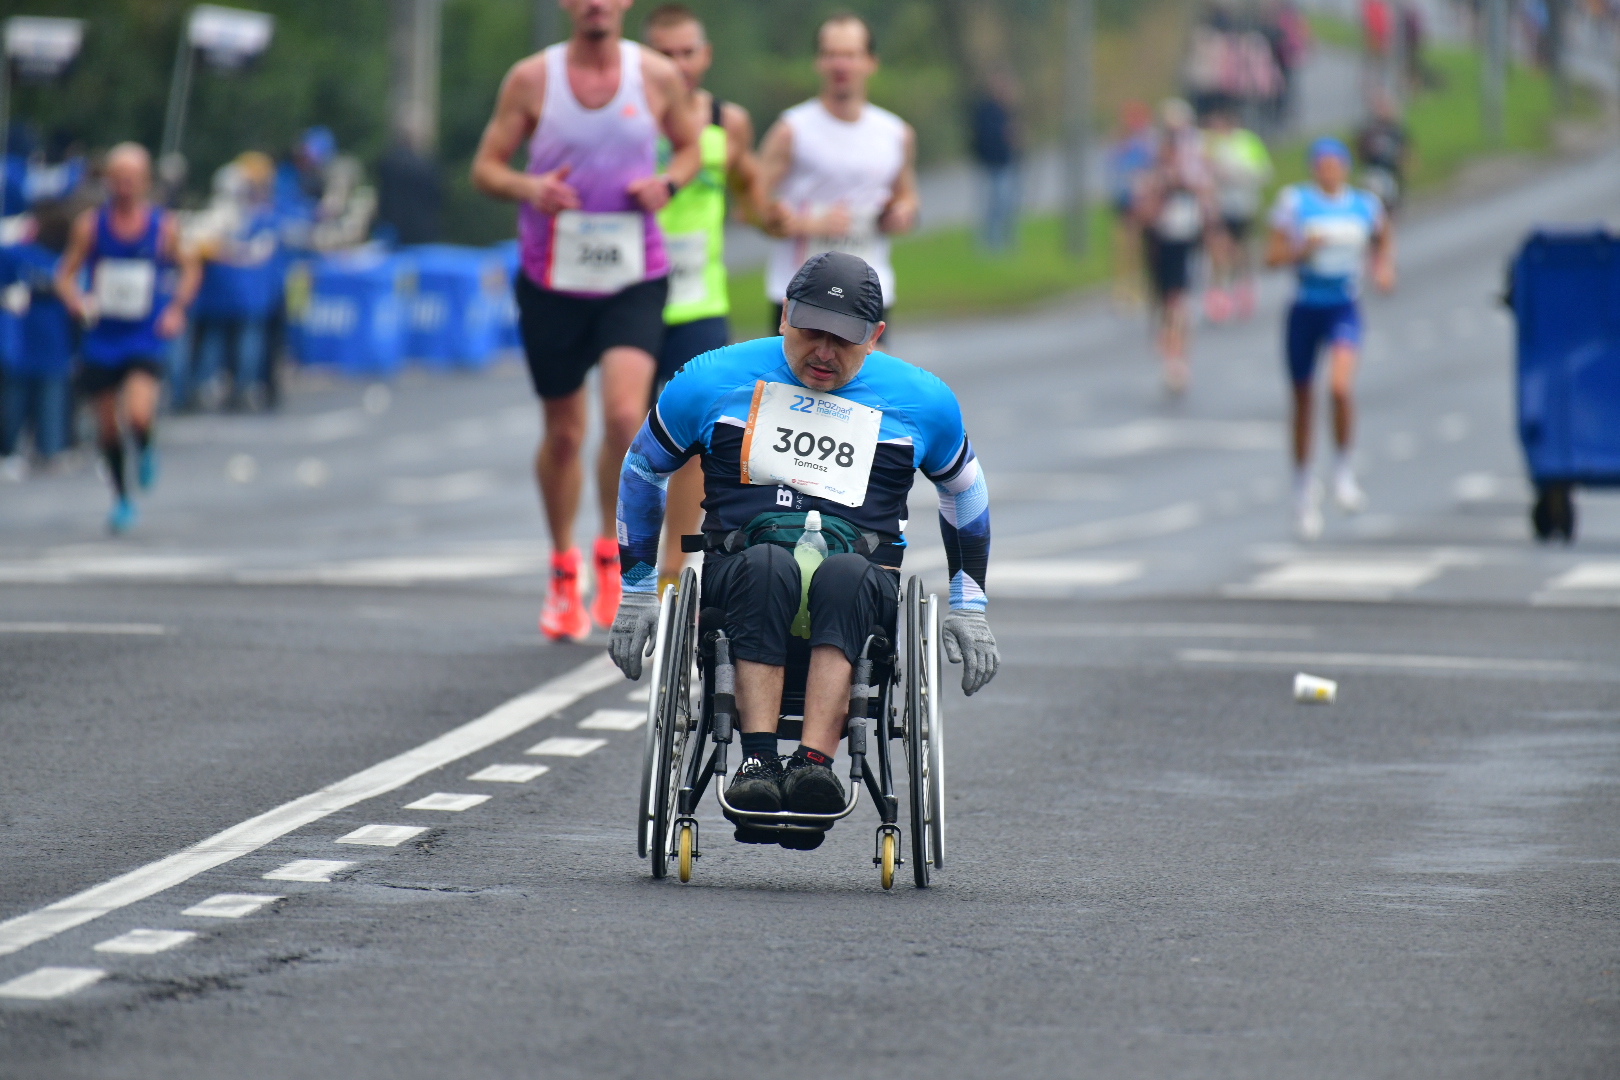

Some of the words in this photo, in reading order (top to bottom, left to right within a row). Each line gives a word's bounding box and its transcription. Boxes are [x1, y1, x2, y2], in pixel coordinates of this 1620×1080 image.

[789, 395, 815, 413] 22
[816, 407, 850, 421] maraton
[772, 426, 855, 468] 3098
[793, 457, 828, 473] Tomasz
